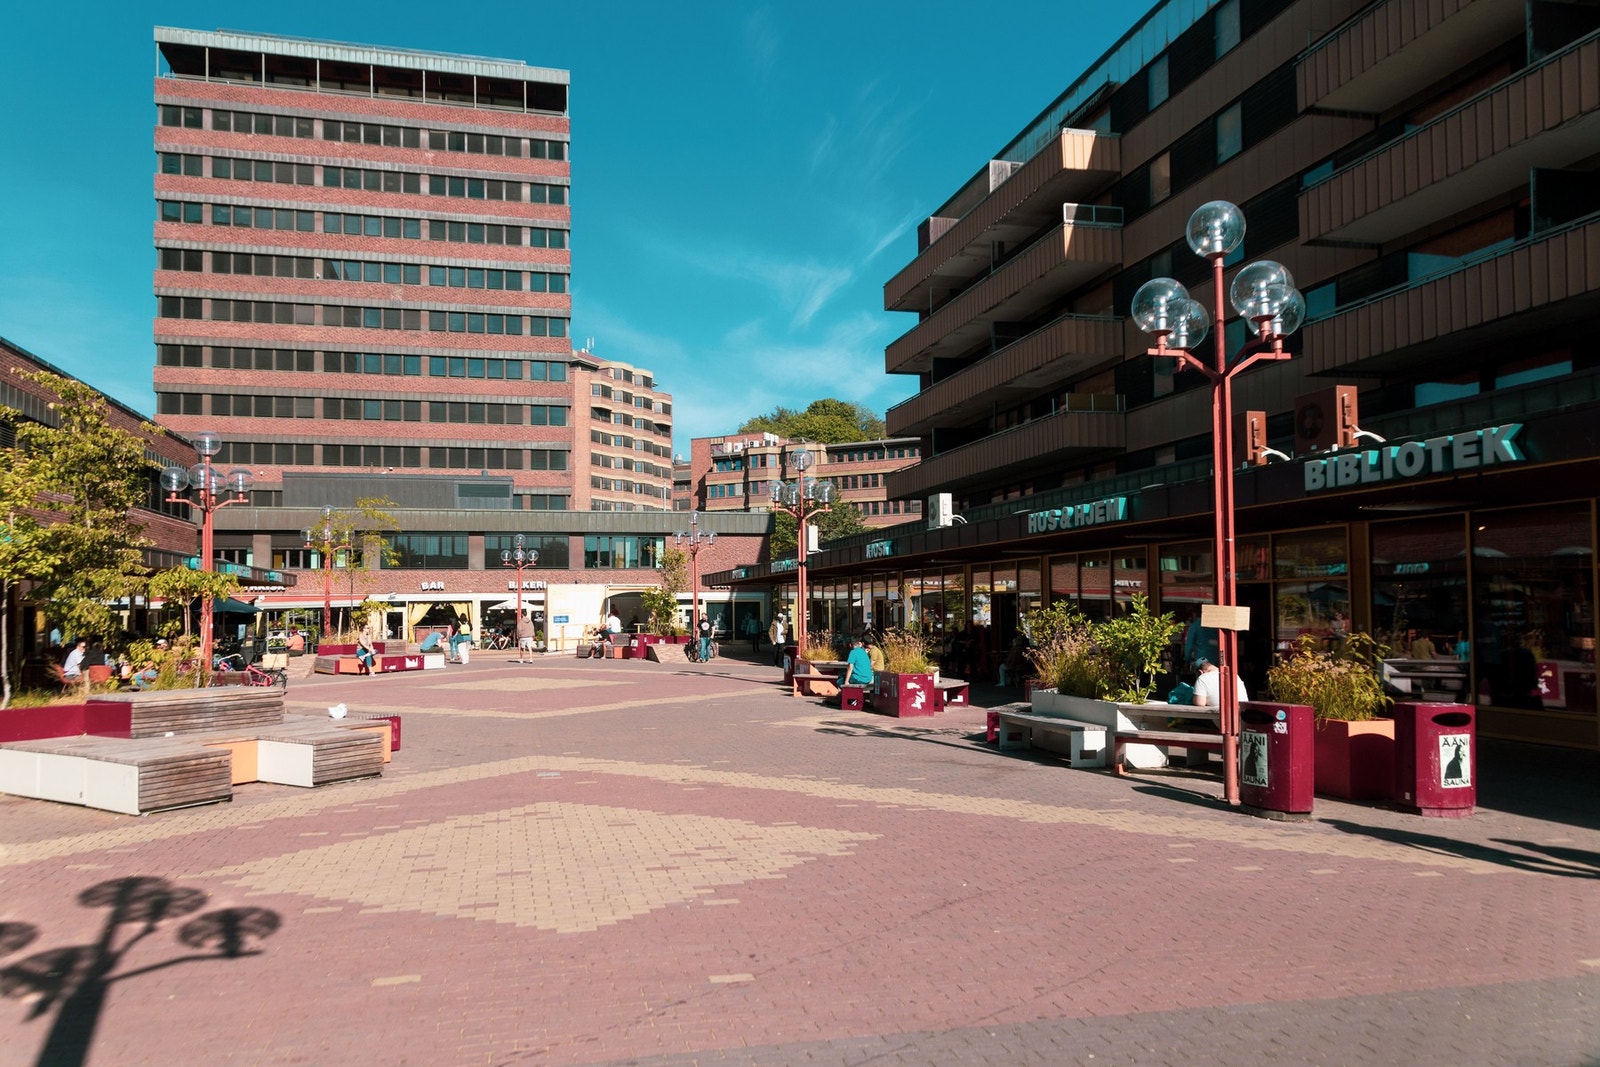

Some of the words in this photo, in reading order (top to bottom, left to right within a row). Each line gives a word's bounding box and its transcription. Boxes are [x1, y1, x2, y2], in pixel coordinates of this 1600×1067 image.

[1304, 424, 1525, 491] BIBLIOTEK
[1028, 509, 1060, 533] HUS
[1060, 506, 1074, 529] &
[1075, 498, 1127, 526] HJEM
[421, 581, 445, 591] BAR
[1443, 779, 1470, 787] SAUNA
